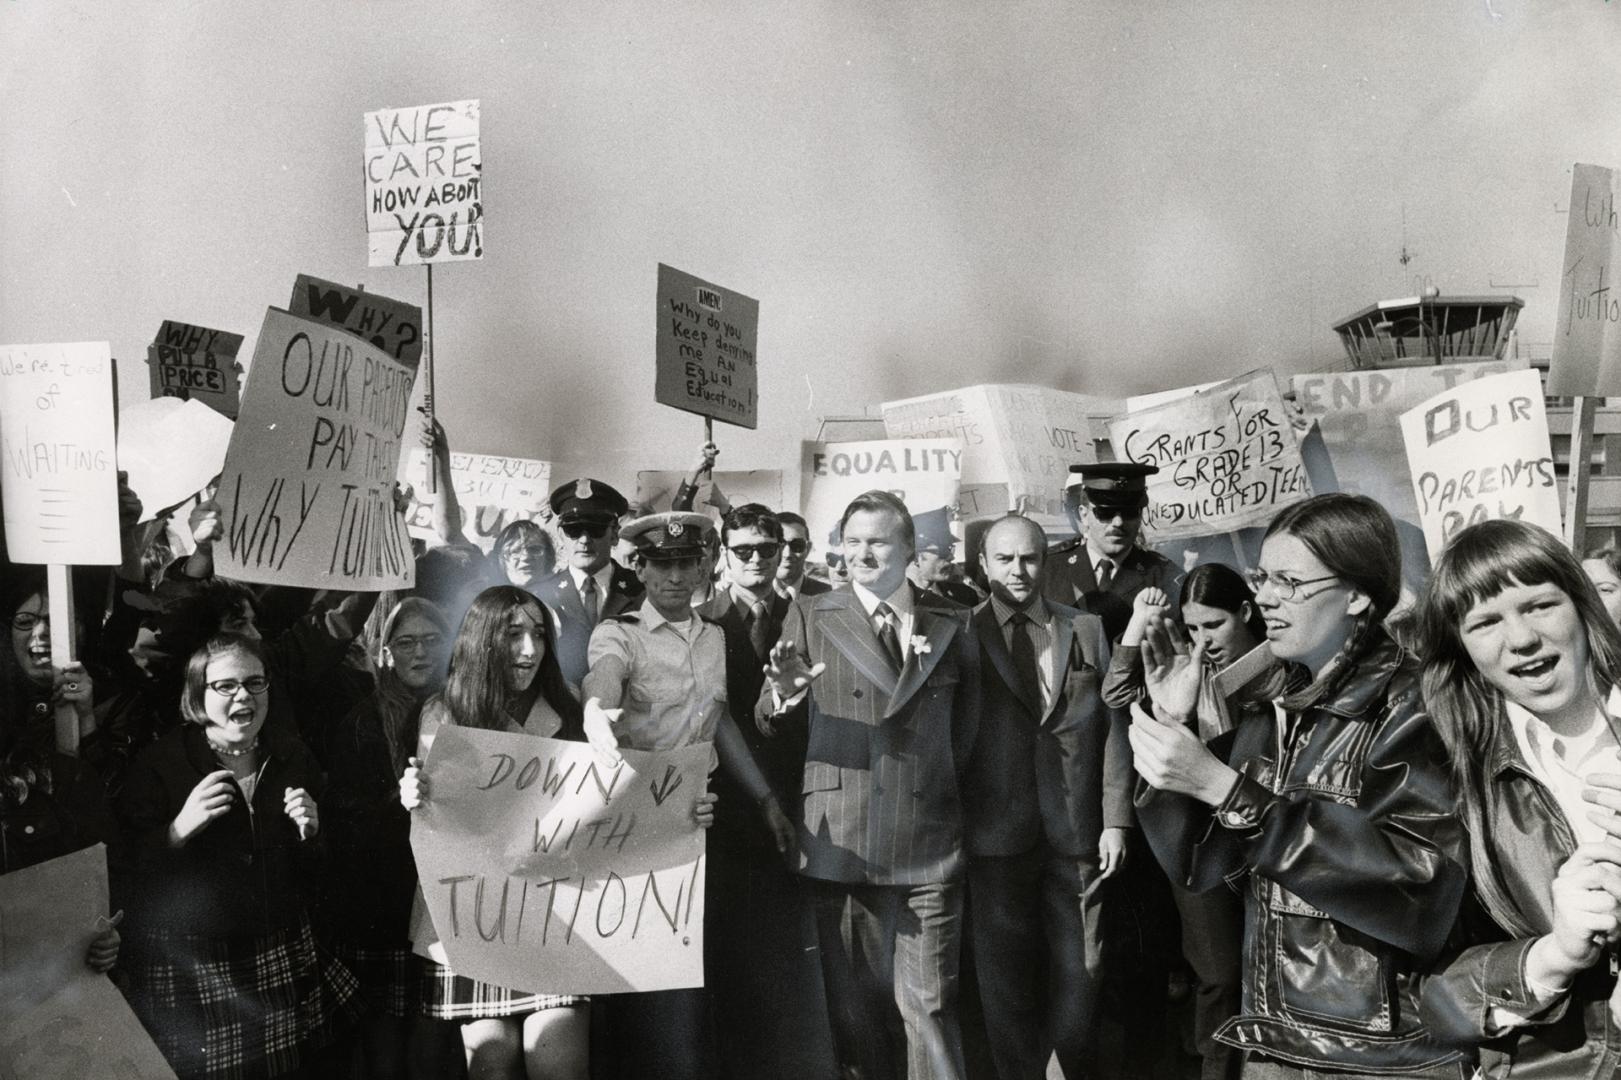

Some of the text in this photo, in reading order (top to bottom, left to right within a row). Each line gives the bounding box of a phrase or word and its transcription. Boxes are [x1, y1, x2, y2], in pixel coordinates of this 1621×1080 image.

[375, 106, 456, 150] WE
[373, 185, 421, 214] HOW
[669, 298, 700, 324] Why
[707, 314, 720, 330] do
[1566, 255, 1621, 336] Tuitio
[166, 322, 219, 354] WHY
[672, 318, 708, 347] Keep
[281, 331, 354, 413] OUR
[1302, 373, 1393, 414] END
[36, 383, 61, 411] of
[307, 415, 359, 471] PAY
[1042, 424, 1082, 453] VOTE
[1124, 425, 1226, 471] GRANTS
[1229, 391, 1280, 444] FOR
[1424, 396, 1533, 448] OUR
[6, 424, 110, 479] WAITING
[813, 447, 963, 478] EQUALITY
[1173, 430, 1284, 490] GRADE 13
[1210, 471, 1244, 497] OR
[1418, 457, 1555, 516] PARENTS
[476, 752, 625, 806] DOWN
[533, 811, 638, 854] WITH
[438, 854, 701, 947] TUITION!
